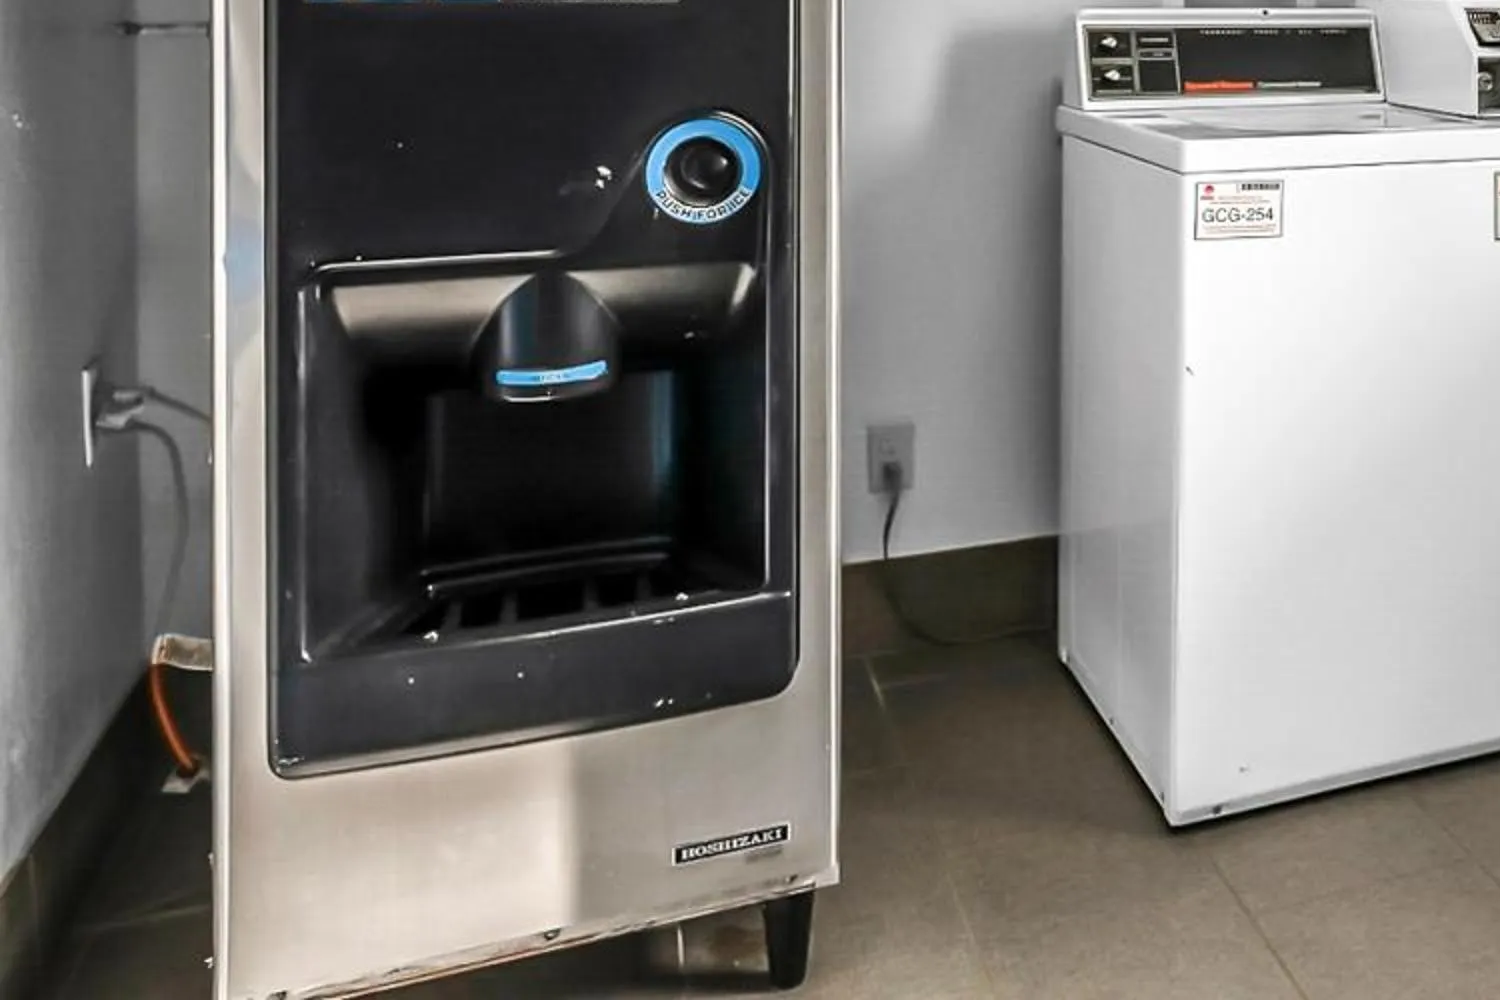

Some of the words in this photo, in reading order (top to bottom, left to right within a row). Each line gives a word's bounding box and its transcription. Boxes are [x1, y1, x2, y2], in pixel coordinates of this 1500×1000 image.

[656, 188, 691, 218] PUSH
[697, 205, 727, 219] FOR
[1201, 206, 1274, 223] GCG-254
[681, 828, 783, 860] HOSHIZAKI
